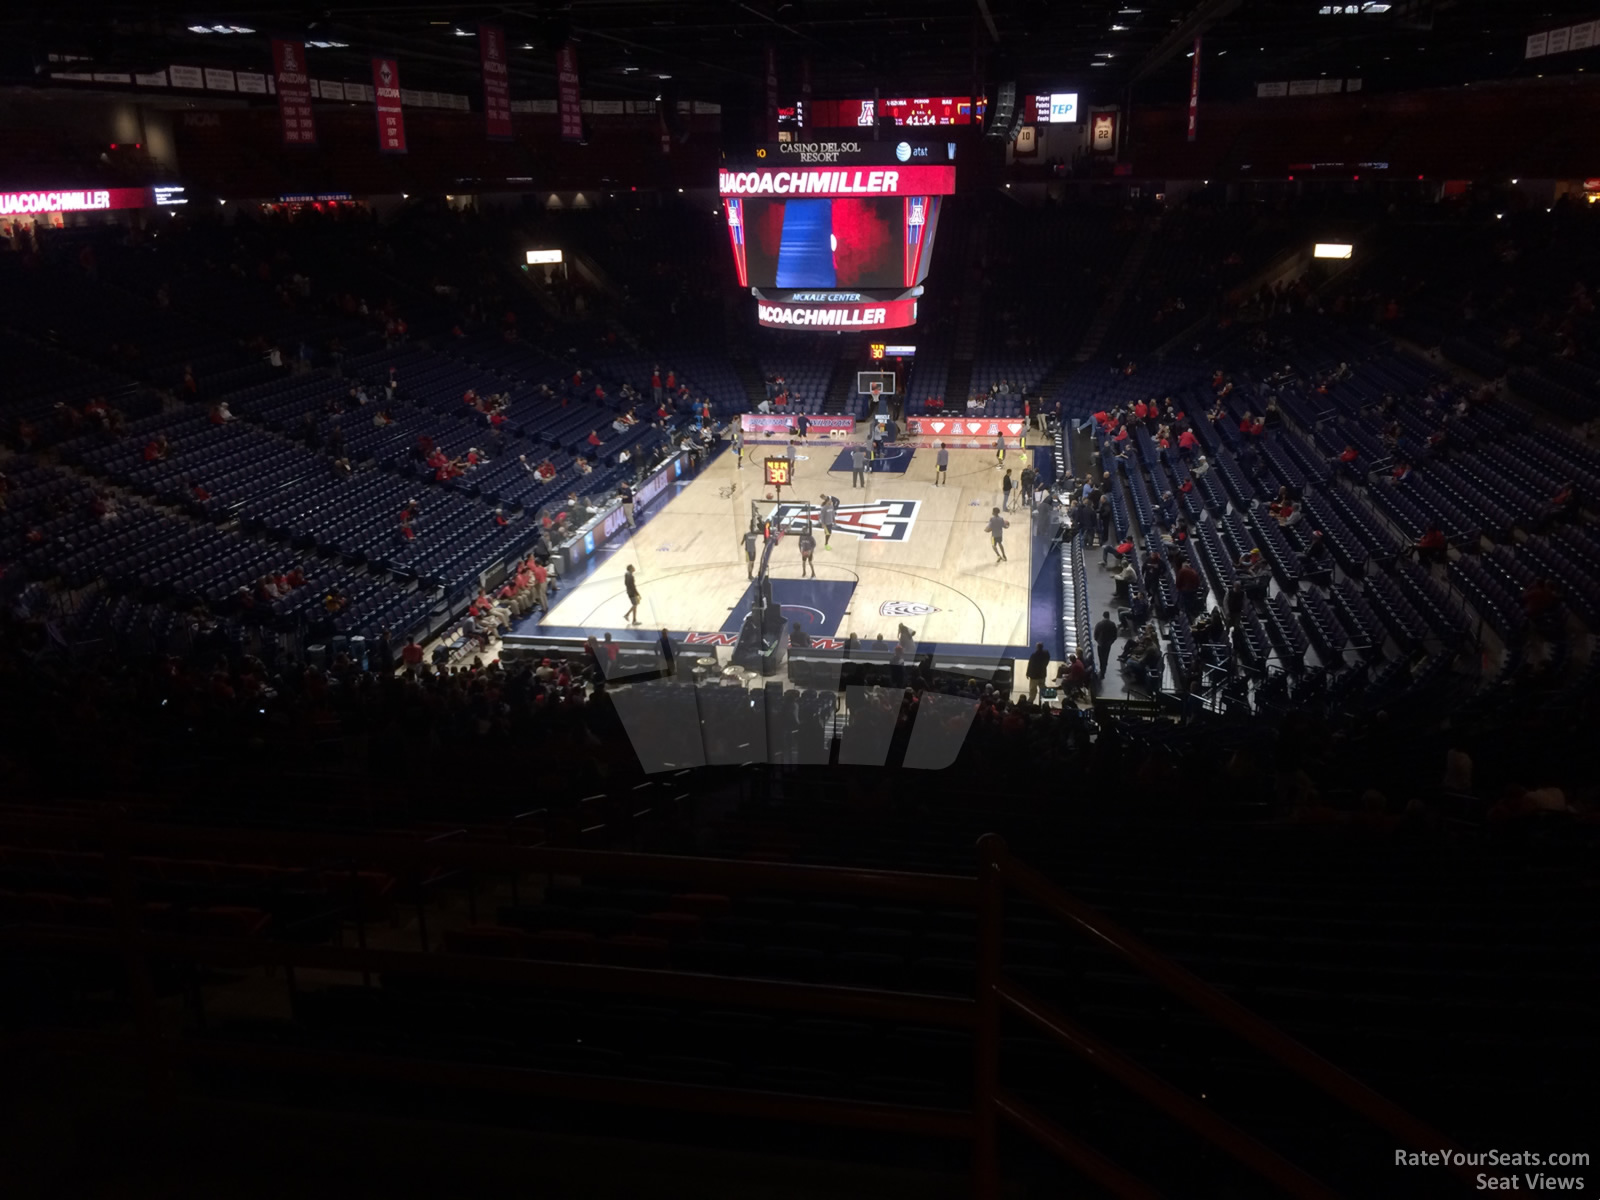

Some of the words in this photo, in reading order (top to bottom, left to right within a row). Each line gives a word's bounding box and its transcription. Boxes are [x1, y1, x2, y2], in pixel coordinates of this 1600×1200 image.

[1052, 105, 1073, 115] TEP
[906, 115, 936, 126] 41:14
[1022, 132, 1031, 140] 10
[1098, 130, 1109, 138] 22
[780, 143, 818, 153] CASINO
[820, 143, 840, 152] DEL
[841, 143, 861, 152] SOL
[801, 152, 839, 162] RESORT
[828, 293, 861, 301] CENTER
[770, 469, 786, 482] 30
